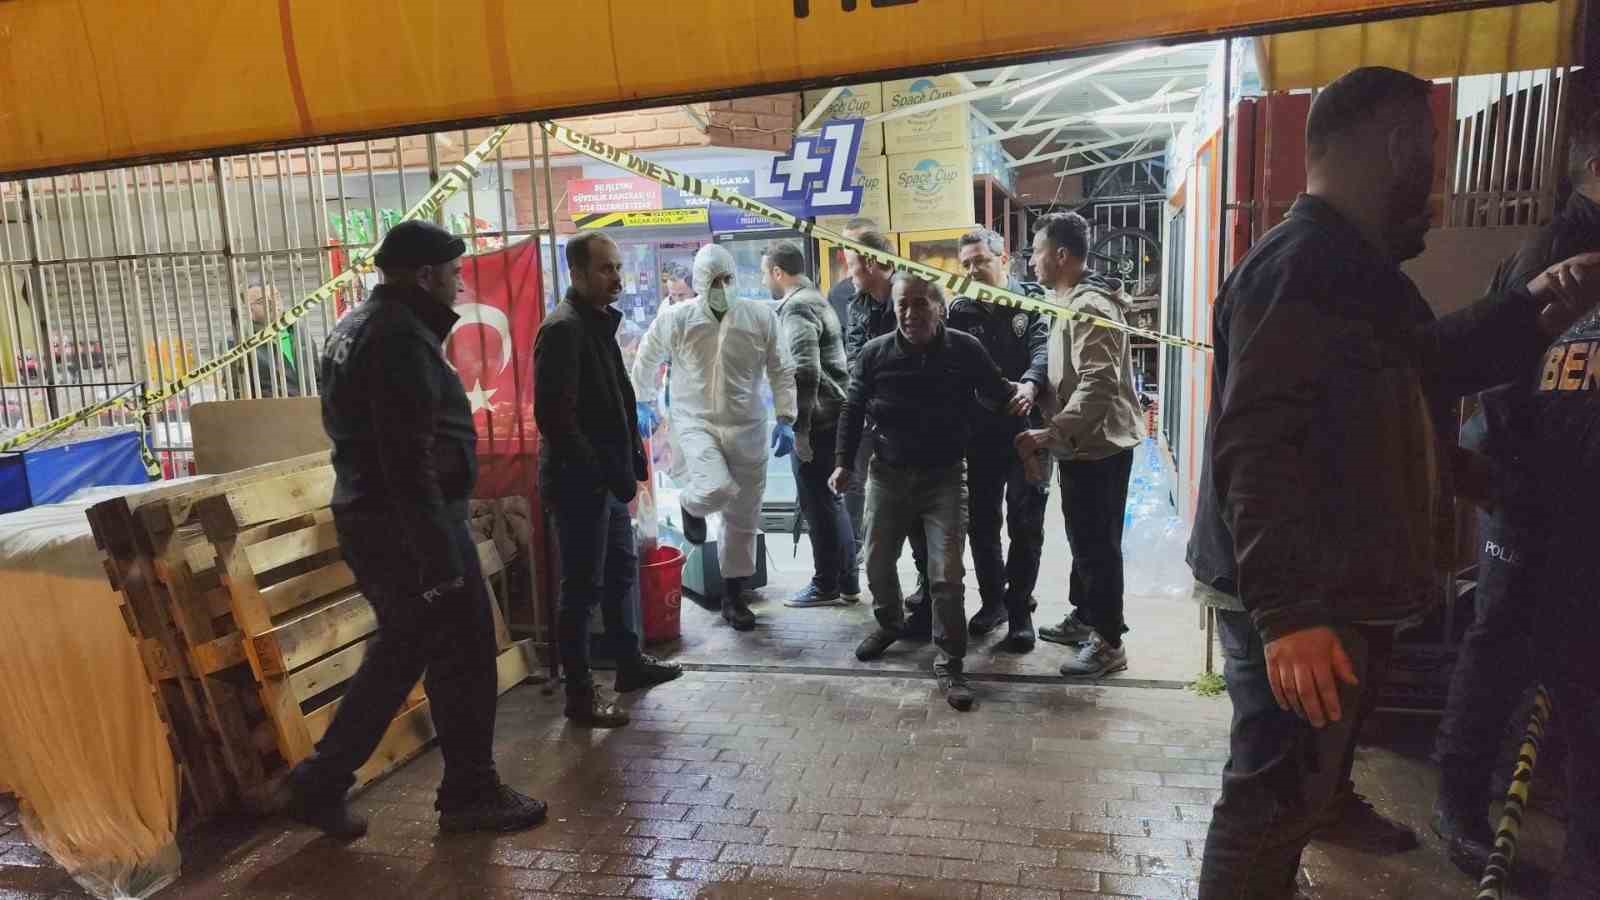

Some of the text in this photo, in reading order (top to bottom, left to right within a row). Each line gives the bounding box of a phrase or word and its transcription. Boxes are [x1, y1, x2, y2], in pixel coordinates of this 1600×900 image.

[847, 98, 870, 115] Cup
[774, 122, 857, 208] +1
[857, 176, 879, 190] Cup
[936, 168, 958, 185] Cup
